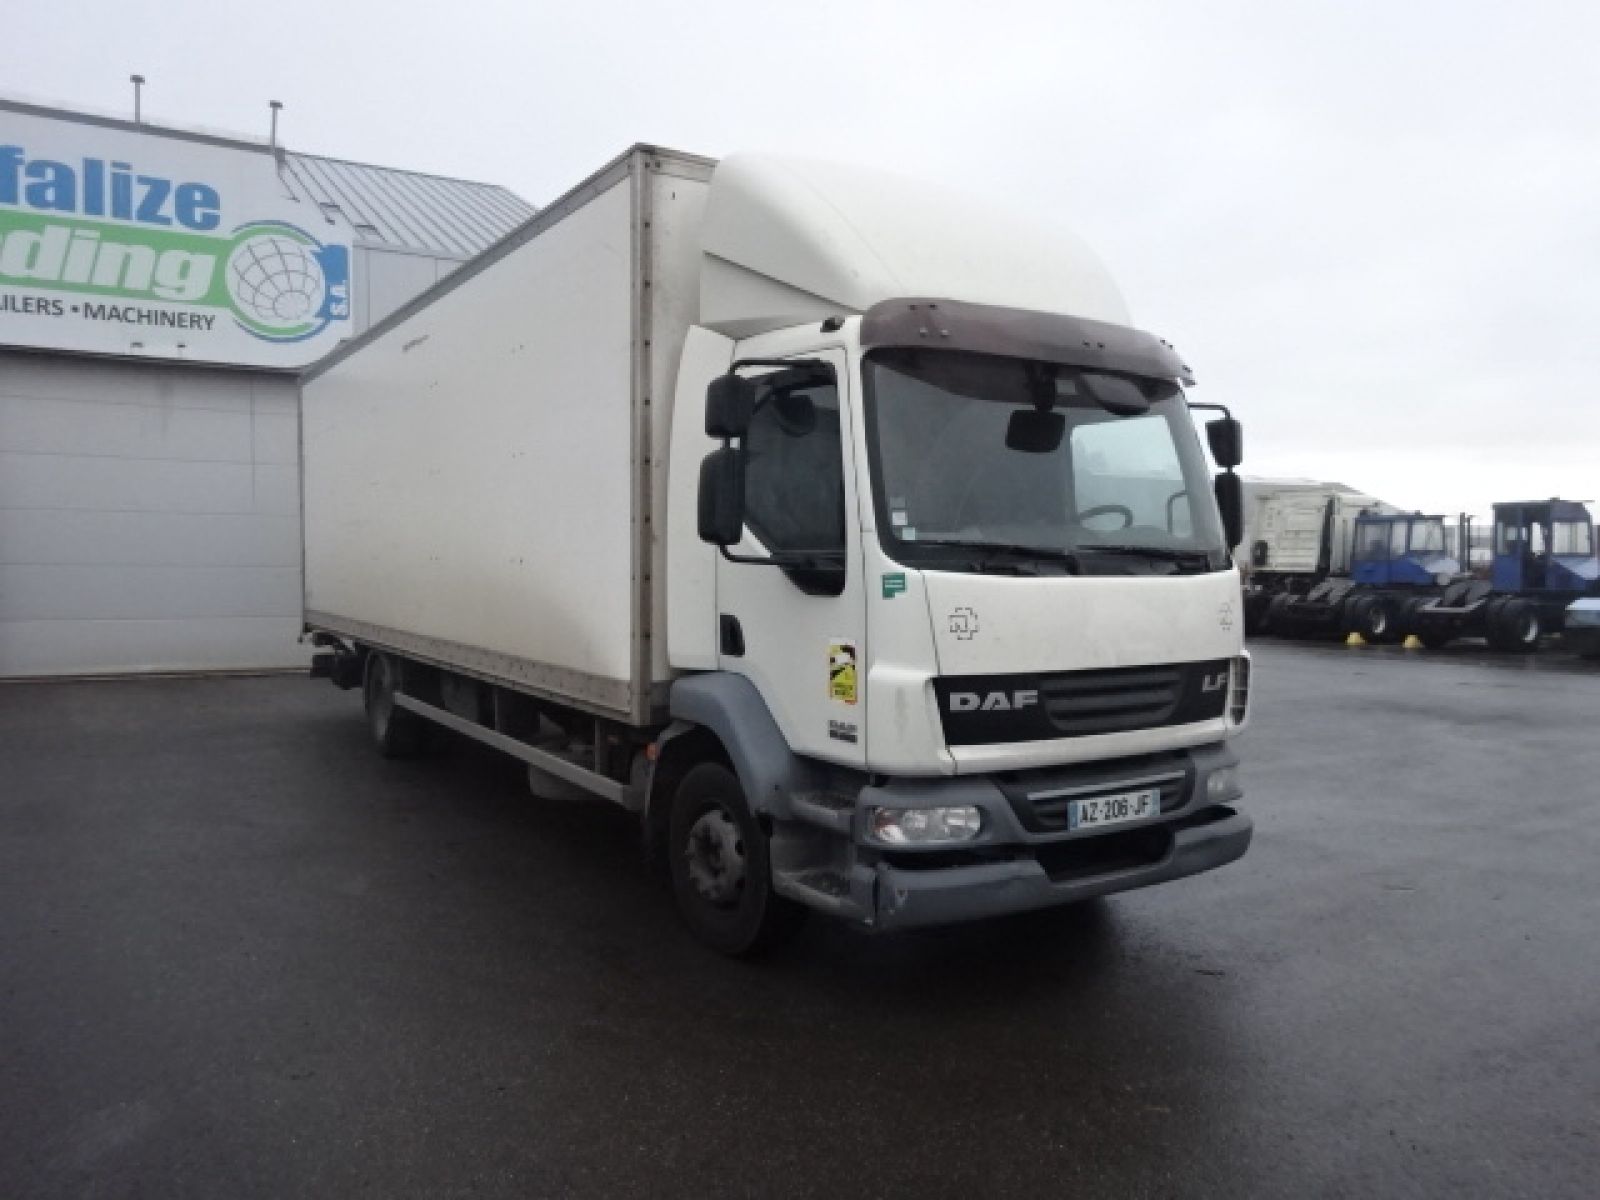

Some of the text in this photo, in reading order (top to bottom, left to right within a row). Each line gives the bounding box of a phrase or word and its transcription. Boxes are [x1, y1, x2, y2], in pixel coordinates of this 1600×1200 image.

[0, 146, 220, 231] falize
[2, 224, 216, 300] ding
[0, 294, 216, 331] ILERS MACHINERY
[949, 689, 1038, 711] DAF
[1202, 672, 1227, 693] LF
